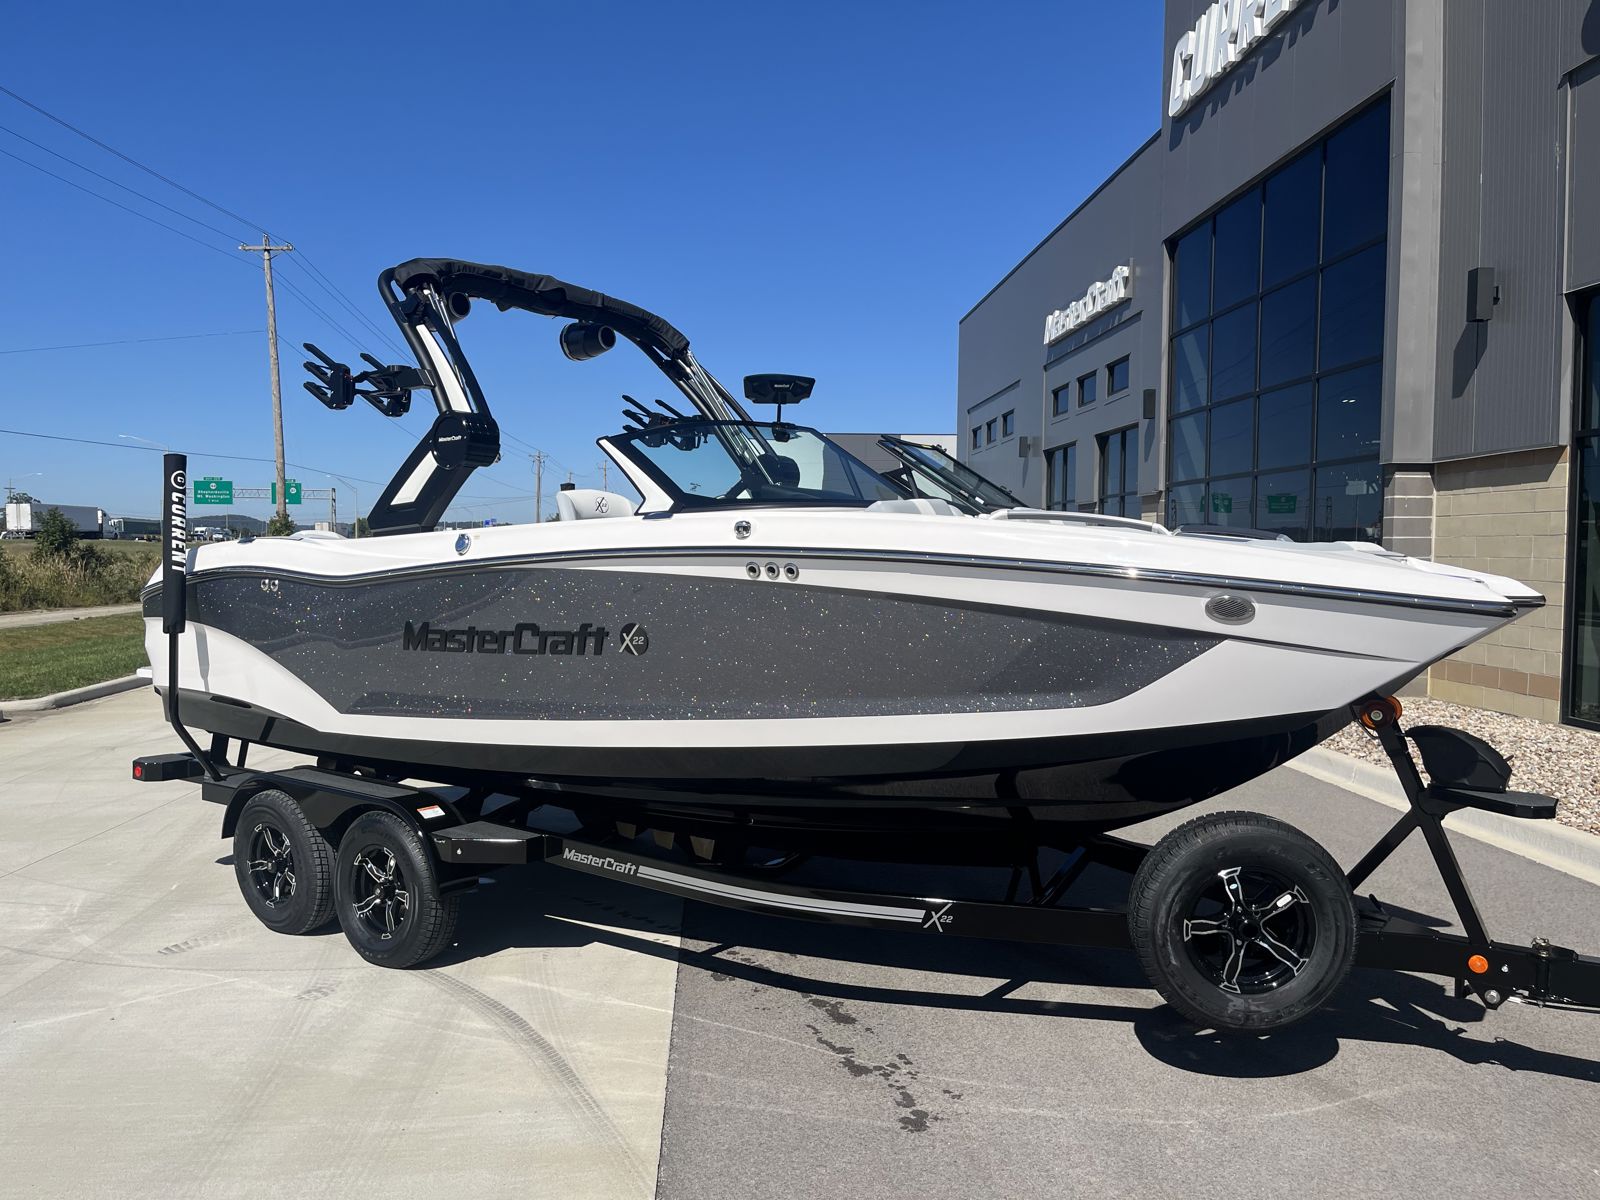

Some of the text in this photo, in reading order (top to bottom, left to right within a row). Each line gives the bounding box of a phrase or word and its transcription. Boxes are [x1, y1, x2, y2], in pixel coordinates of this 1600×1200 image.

[1043, 265, 1130, 345] MasterCraft
[171, 491, 186, 575] CURRENT
[402, 620, 610, 656] MasterCraft
[562, 847, 637, 876] MasterCraft
